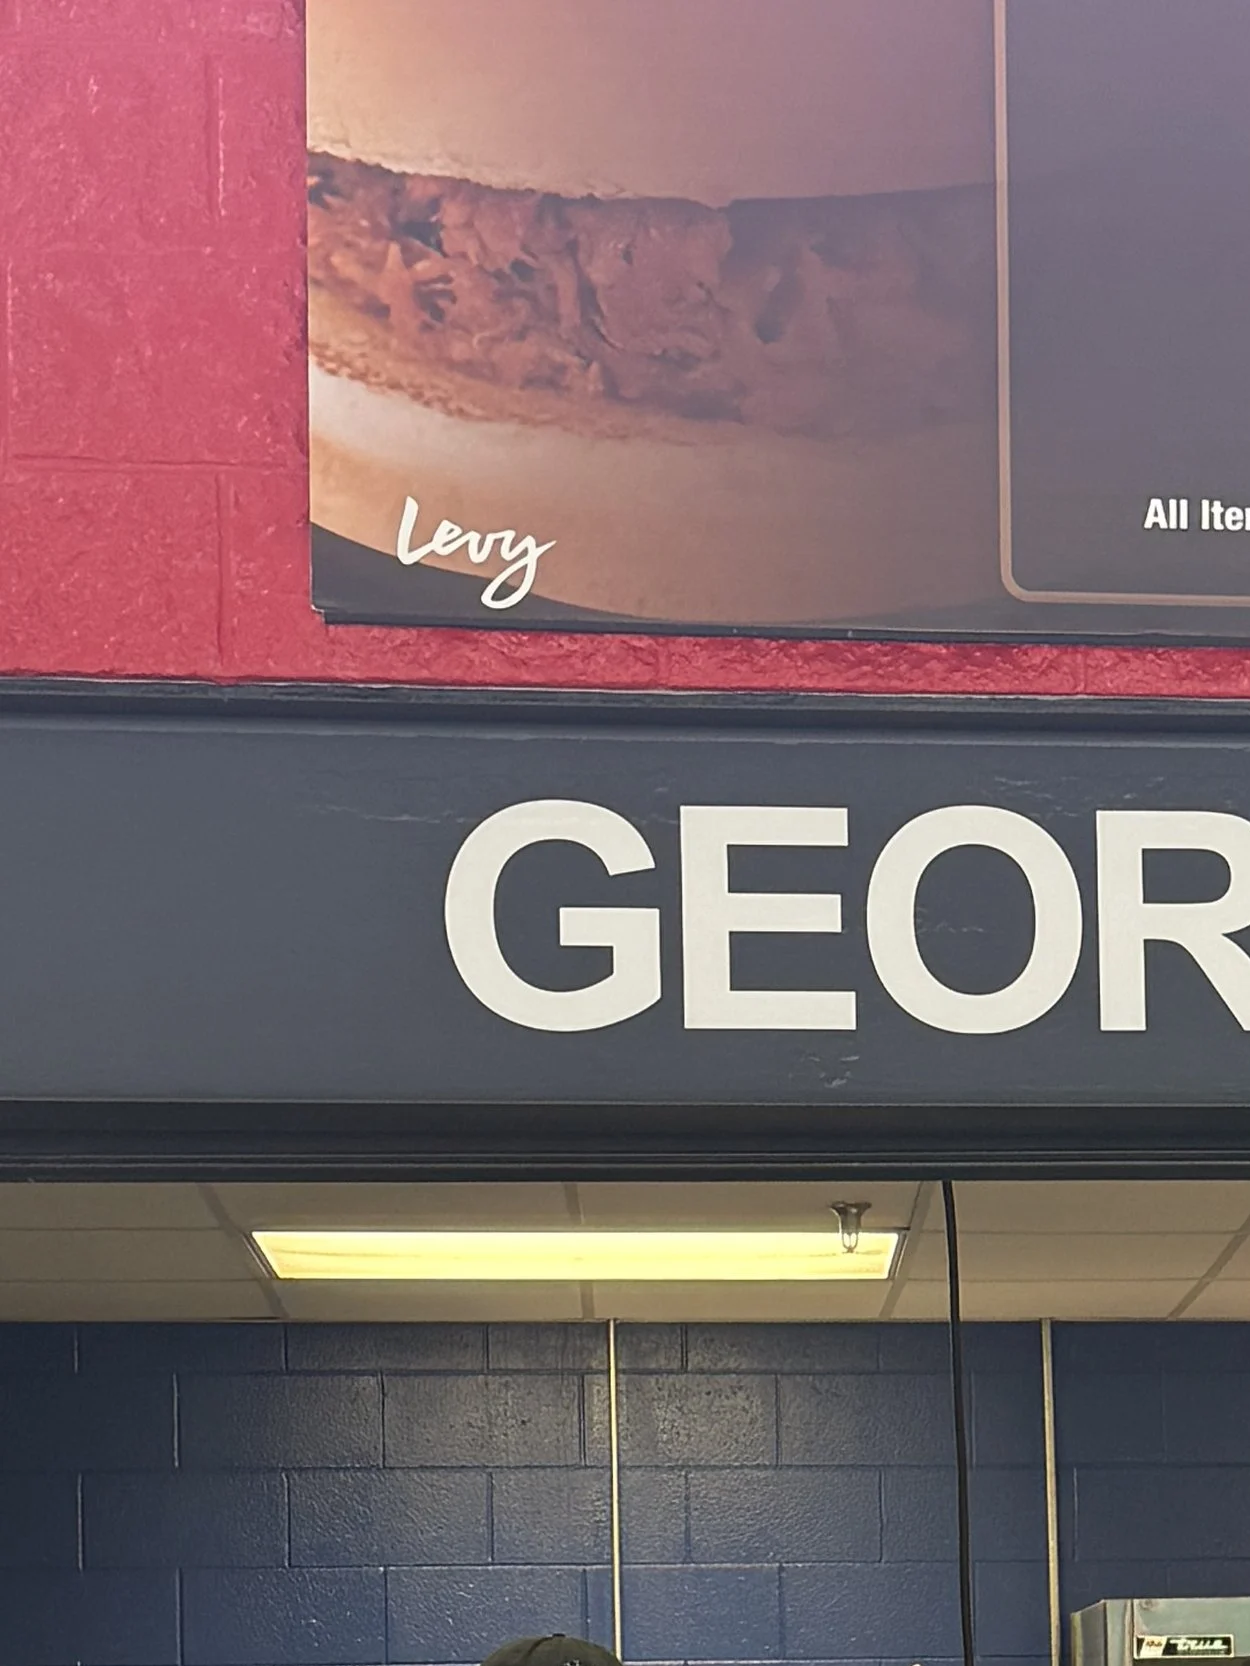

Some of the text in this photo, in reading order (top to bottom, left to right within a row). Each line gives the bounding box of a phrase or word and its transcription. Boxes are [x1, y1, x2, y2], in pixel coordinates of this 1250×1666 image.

[1144, 498, 1189, 530] All
[397, 495, 557, 609] Levy
[1169, 1638, 1229, 1651] true
